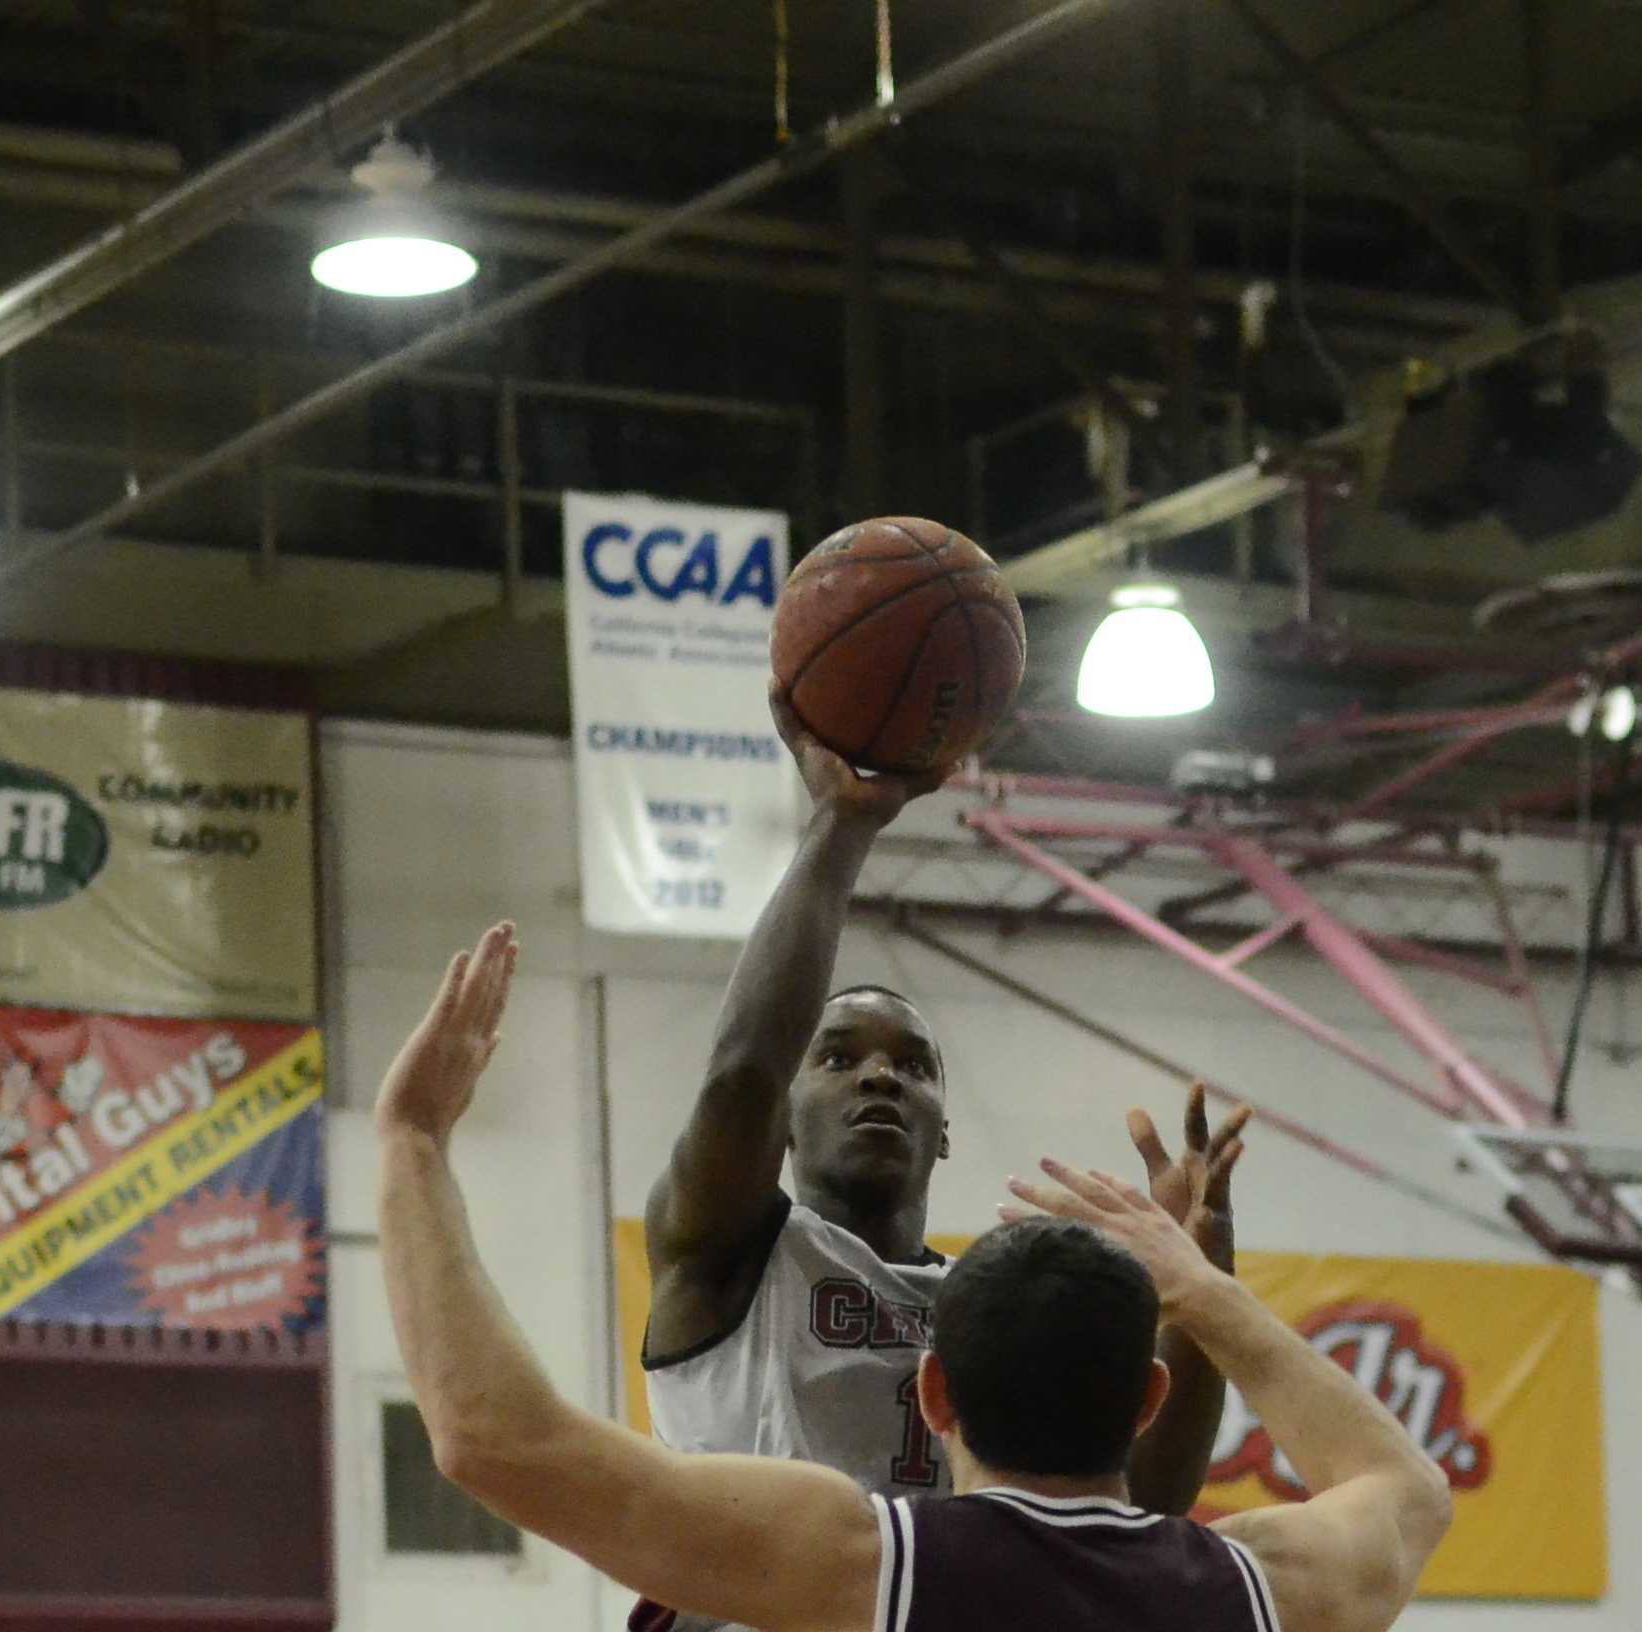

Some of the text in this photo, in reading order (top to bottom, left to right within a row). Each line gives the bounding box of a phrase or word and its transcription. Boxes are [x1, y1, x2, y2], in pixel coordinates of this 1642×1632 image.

[583, 521, 778, 609] CCAA
[587, 724, 780, 762] CHAMPIONS
[98, 774, 299, 815] COMMUNITY
[91, 1031, 248, 1151] Guys
[167, 1053, 319, 1174] RENTALS
